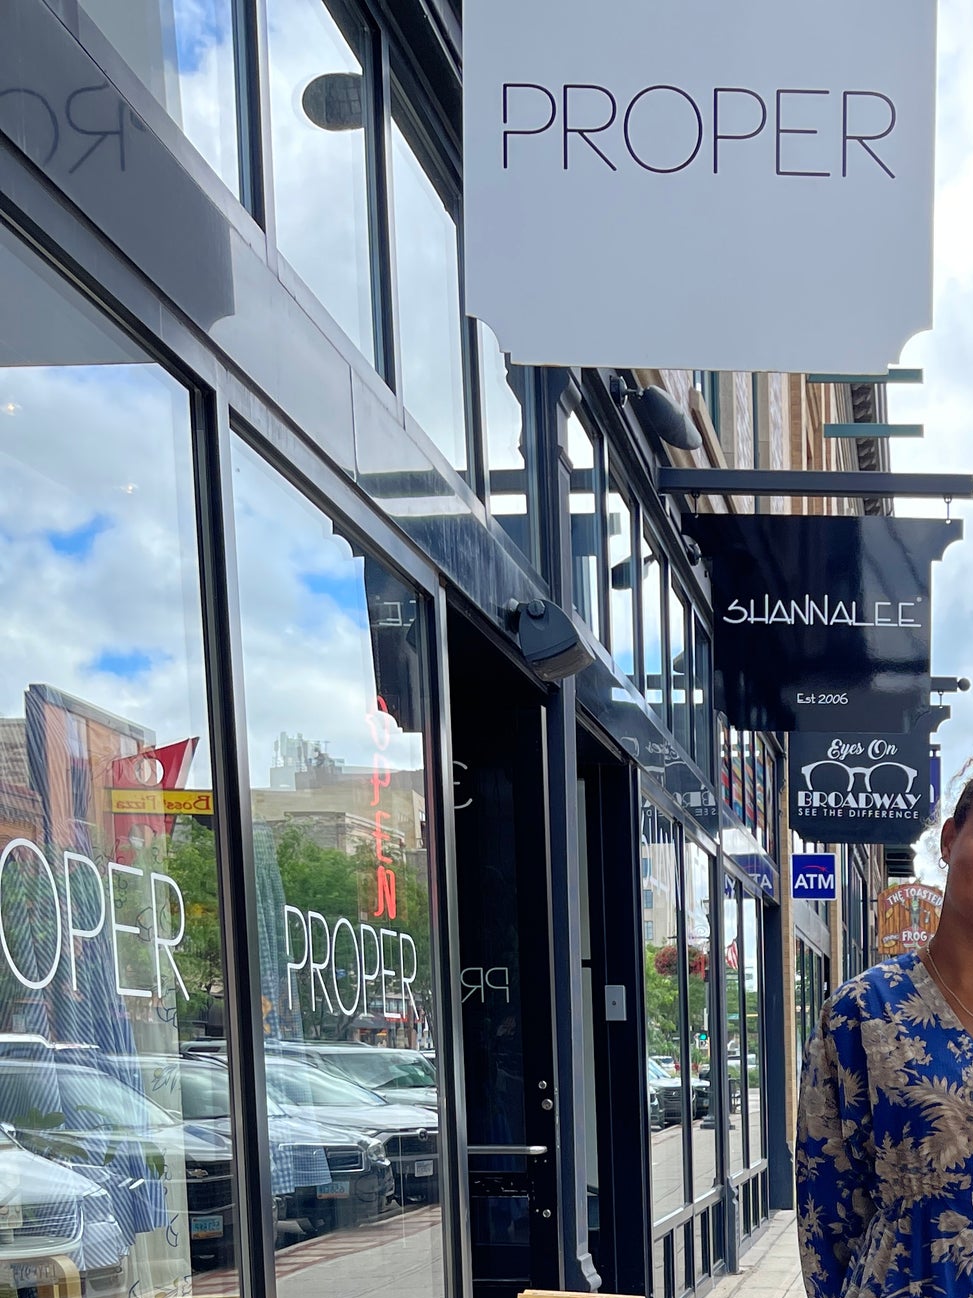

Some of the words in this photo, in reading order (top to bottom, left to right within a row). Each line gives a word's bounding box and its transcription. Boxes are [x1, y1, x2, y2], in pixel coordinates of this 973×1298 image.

[502, 82, 896, 179] PROPER
[722, 593, 922, 628] SHANNALEE
[797, 692, 816, 704] Est
[818, 692, 849, 705] 2006
[827, 738, 864, 760] Eyes
[867, 739, 898, 760] On
[797, 791, 922, 810] BROADWAY
[798, 808, 817, 816] SEE
[823, 808, 843, 817] THE
[849, 809, 919, 819] DIFFERENCE
[794, 873, 835, 889] ATM
[887, 890, 904, 905] THE
[902, 931, 927, 942] FROG
[284, 904, 420, 1021] PROPER
